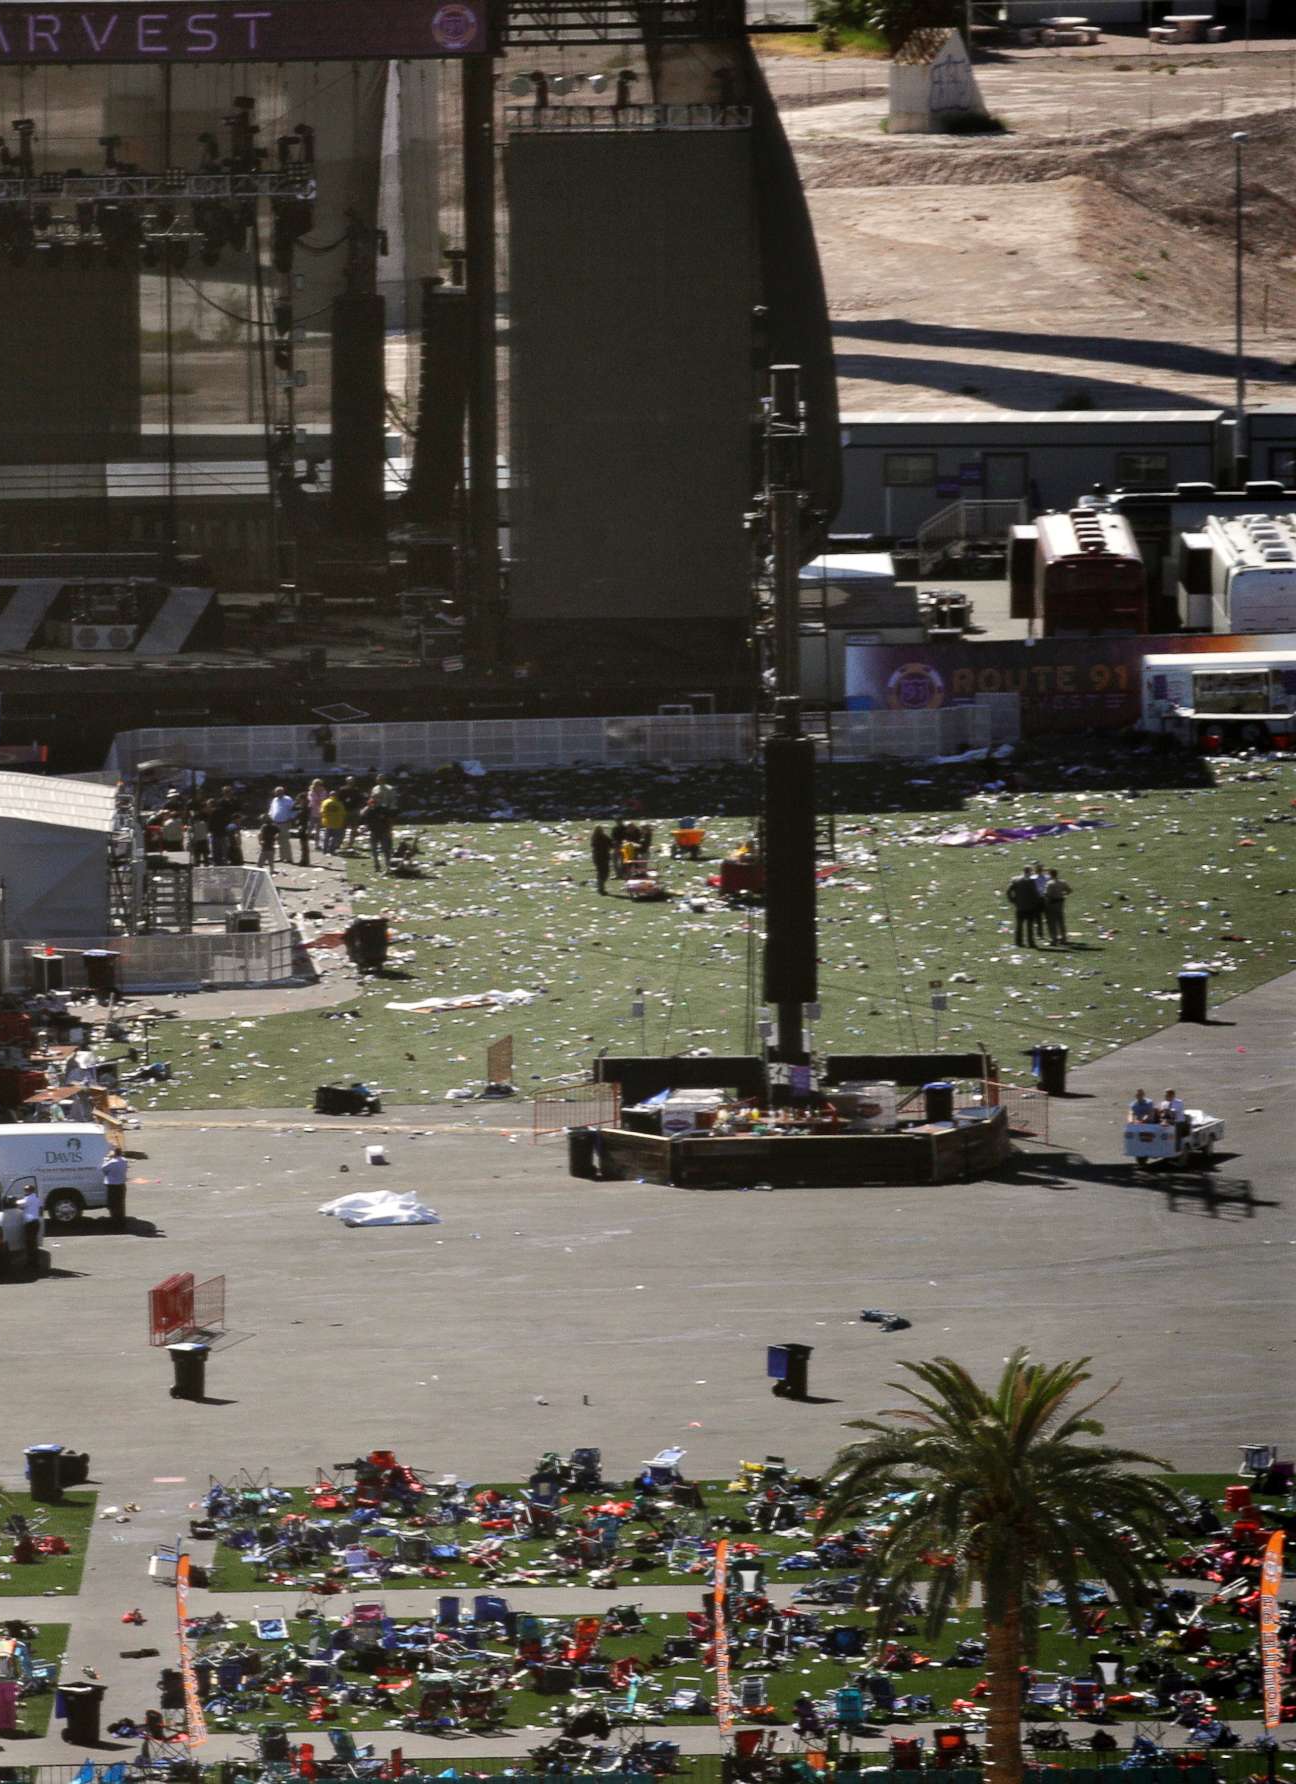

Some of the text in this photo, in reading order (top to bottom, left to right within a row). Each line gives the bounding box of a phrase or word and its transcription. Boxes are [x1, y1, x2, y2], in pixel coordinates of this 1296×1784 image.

[951, 664, 1130, 692] ROUTE 91
[45, 1151, 83, 1164] DAVIS
